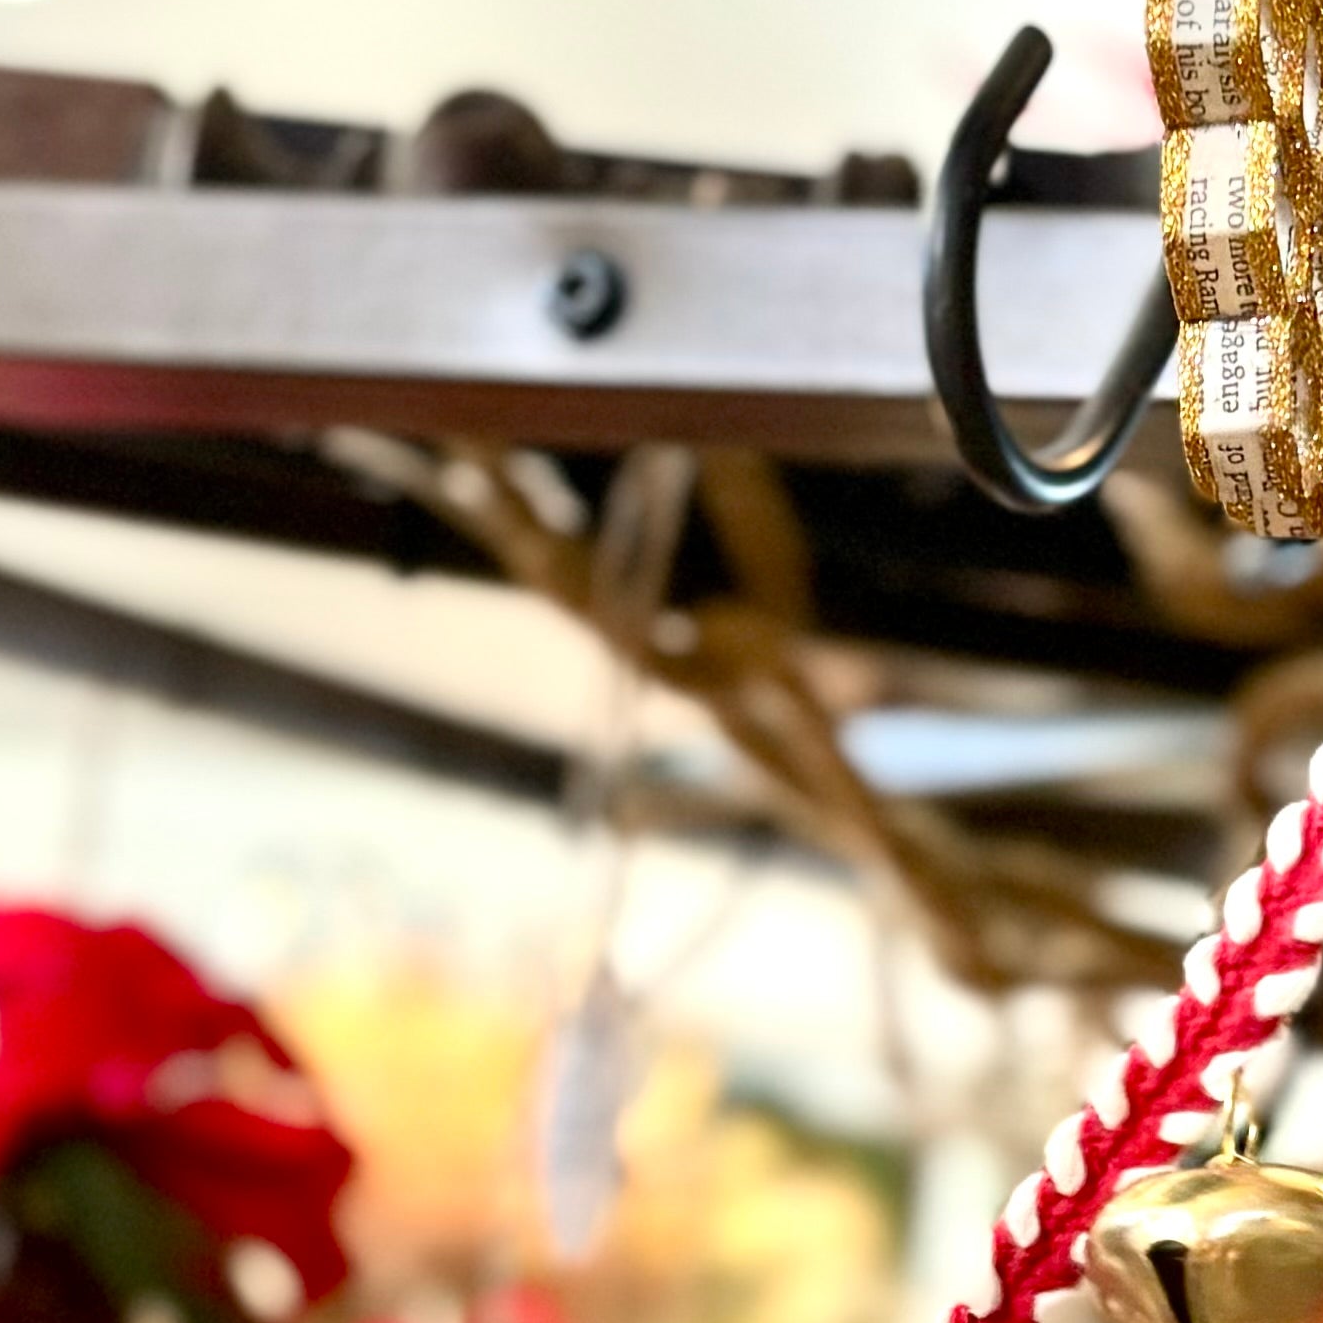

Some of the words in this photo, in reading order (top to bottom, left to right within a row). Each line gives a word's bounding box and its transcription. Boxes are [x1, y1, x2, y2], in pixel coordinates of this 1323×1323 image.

[1176, 0, 1202, 31] of
[1176, 43, 1203, 81] his
[1187, 178, 1212, 261] racing
[1228, 238, 1255, 297] more
[1218, 444, 1244, 464] of
